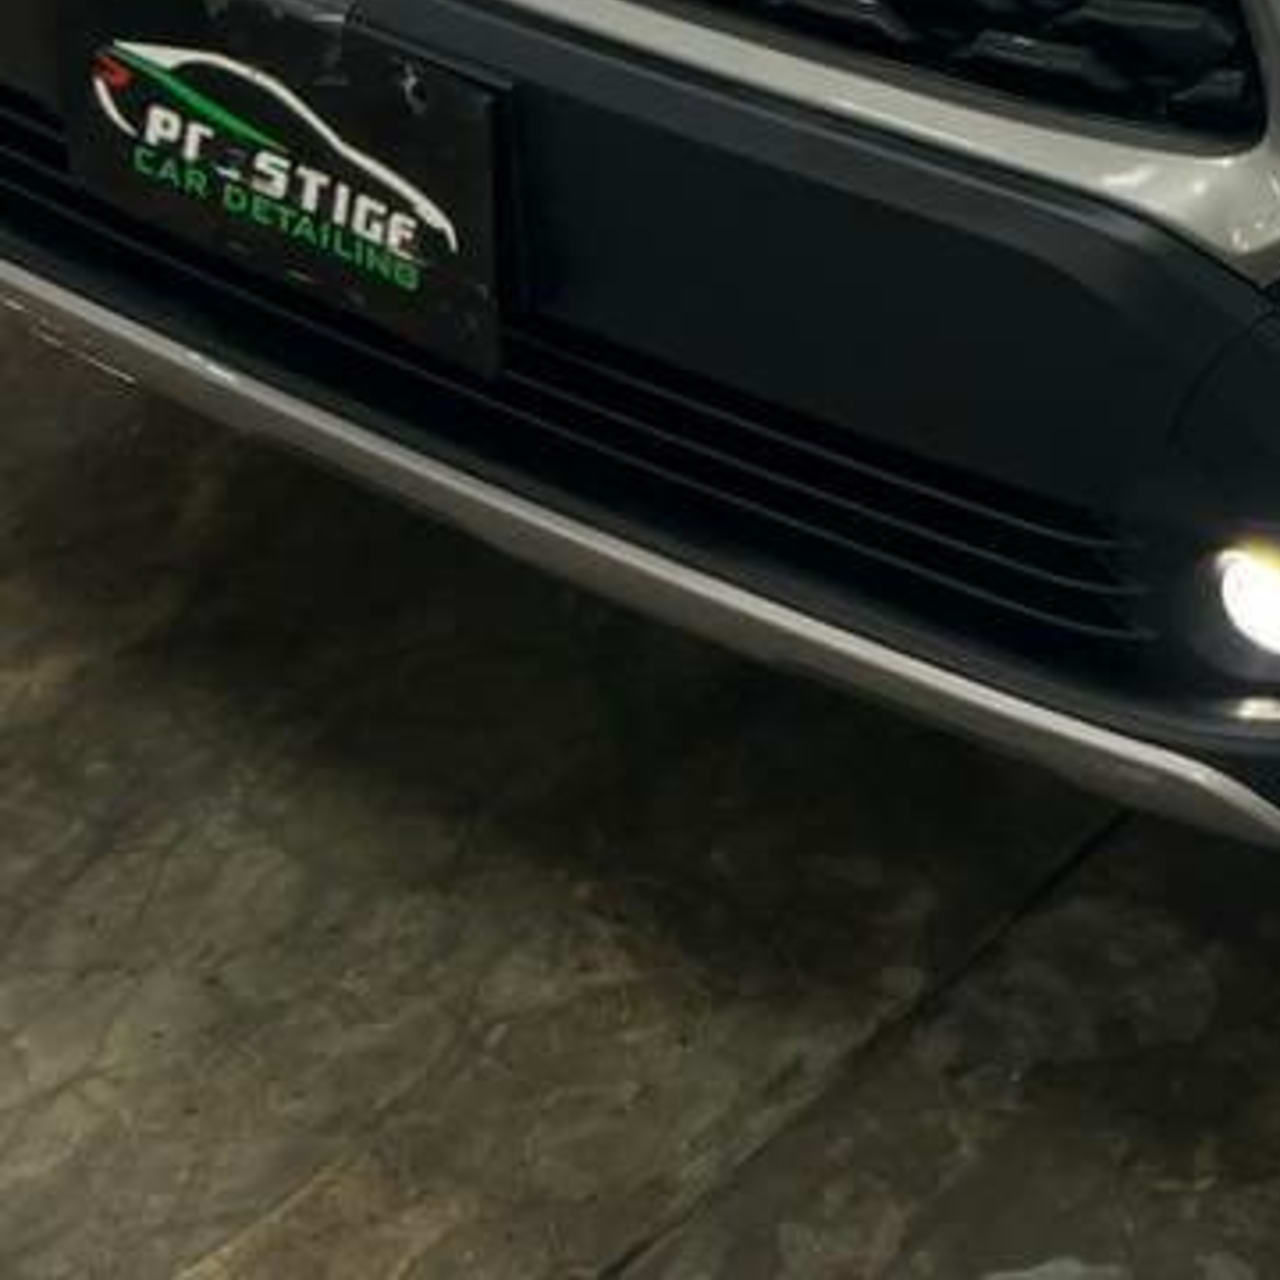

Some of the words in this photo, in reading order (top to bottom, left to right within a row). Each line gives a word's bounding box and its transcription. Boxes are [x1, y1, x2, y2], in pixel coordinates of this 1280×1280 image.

[133, 146, 208, 197] CAR
[222, 184, 420, 290] DETAILING
[144, 104, 418, 261] PSTIGE
